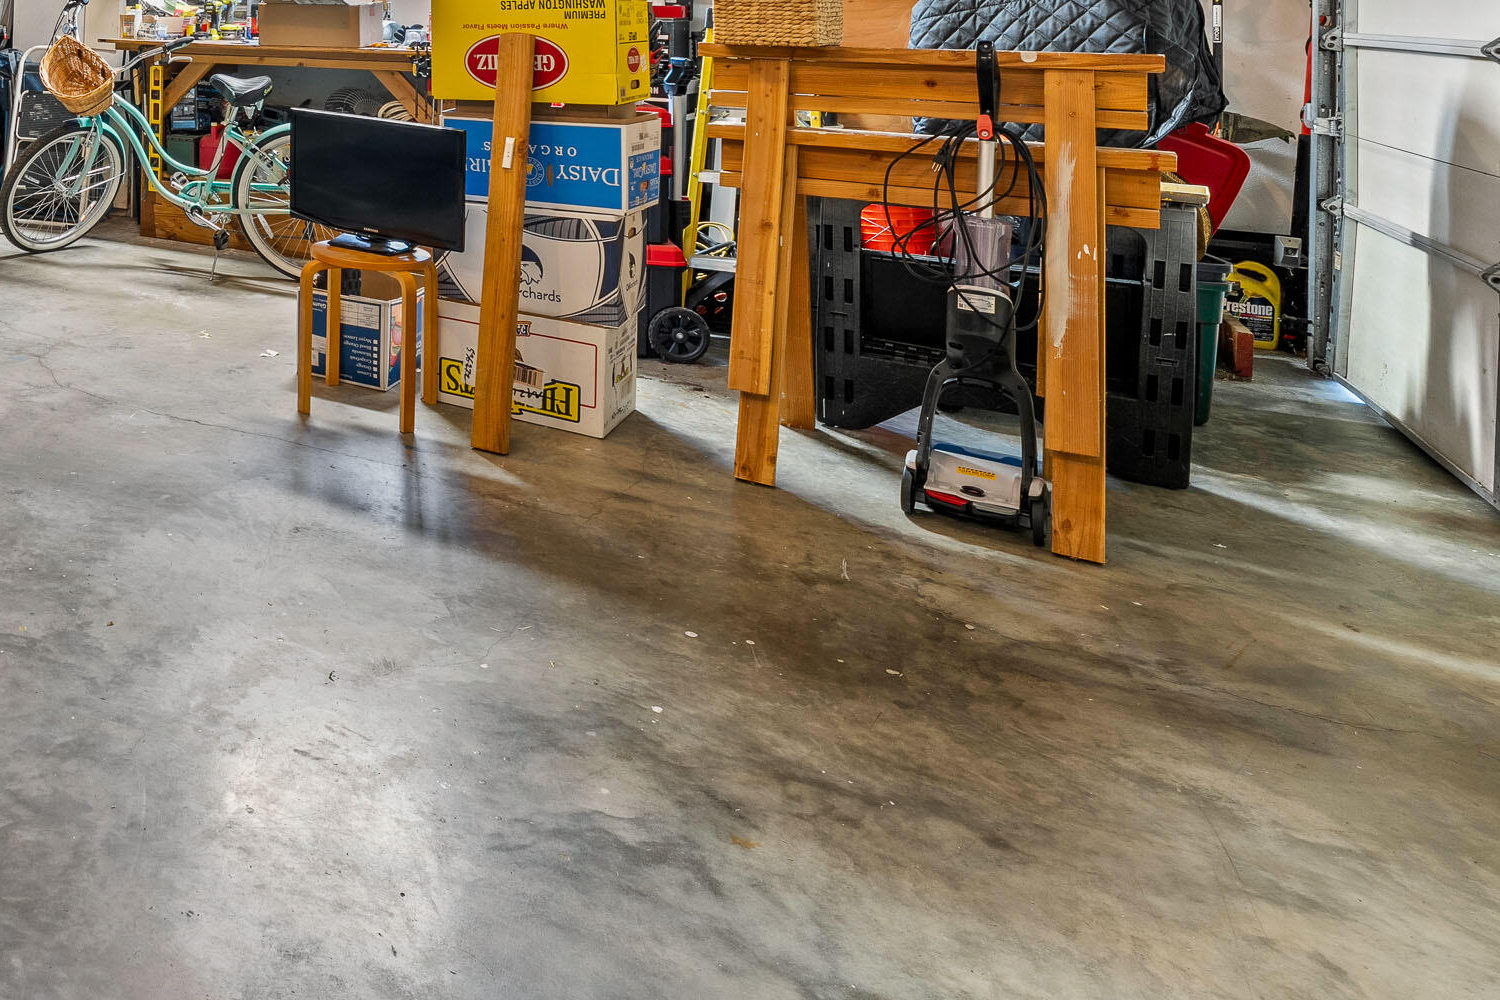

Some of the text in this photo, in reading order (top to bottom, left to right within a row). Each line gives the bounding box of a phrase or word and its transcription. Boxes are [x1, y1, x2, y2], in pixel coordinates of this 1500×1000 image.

[500, 0, 535, 11] APPLES
[564, 10, 606, 19] PREMIUM
[533, 54, 556, 72] GE
[483, 141, 577, 157] ORGAS
[556, 165, 621, 187] DAISY
[519, 287, 561, 302] chards
